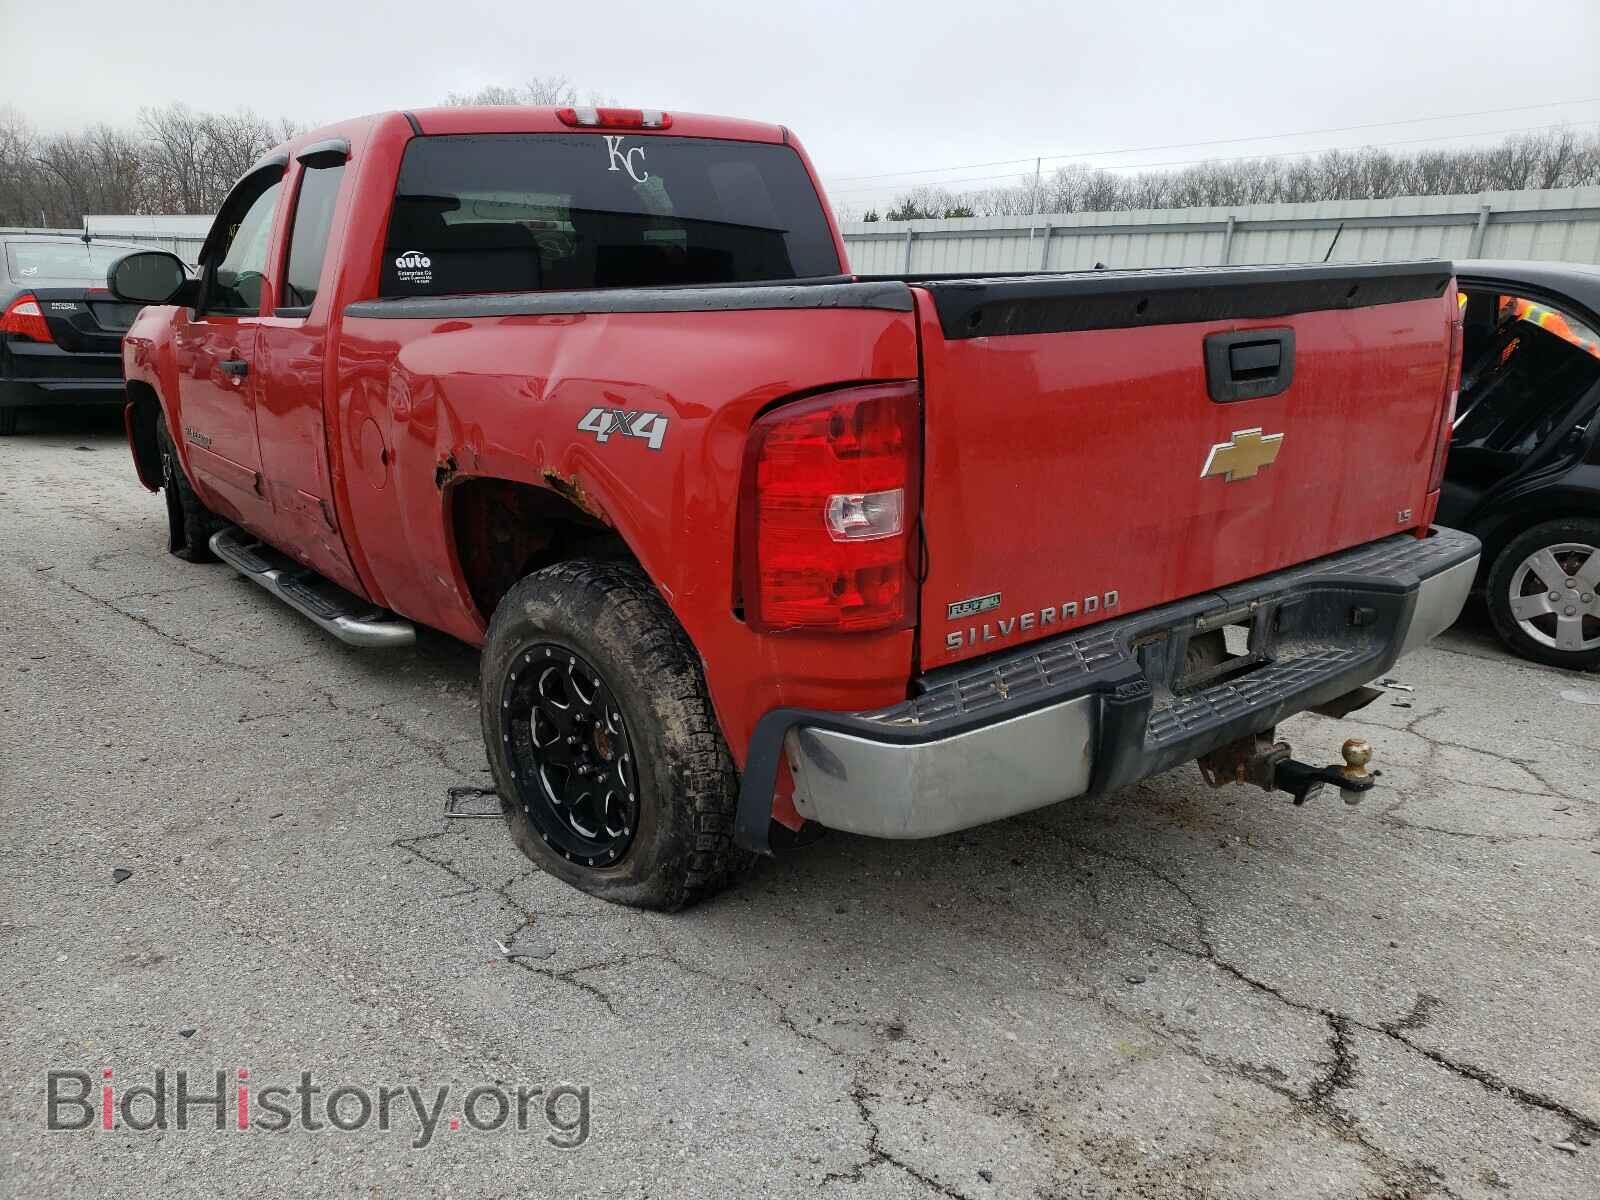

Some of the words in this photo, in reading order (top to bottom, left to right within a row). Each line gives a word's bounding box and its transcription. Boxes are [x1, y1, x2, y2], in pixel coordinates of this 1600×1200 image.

[602, 135, 648, 183] KC
[395, 254, 431, 268] auto
[945, 590, 1119, 650] SILVERADO
